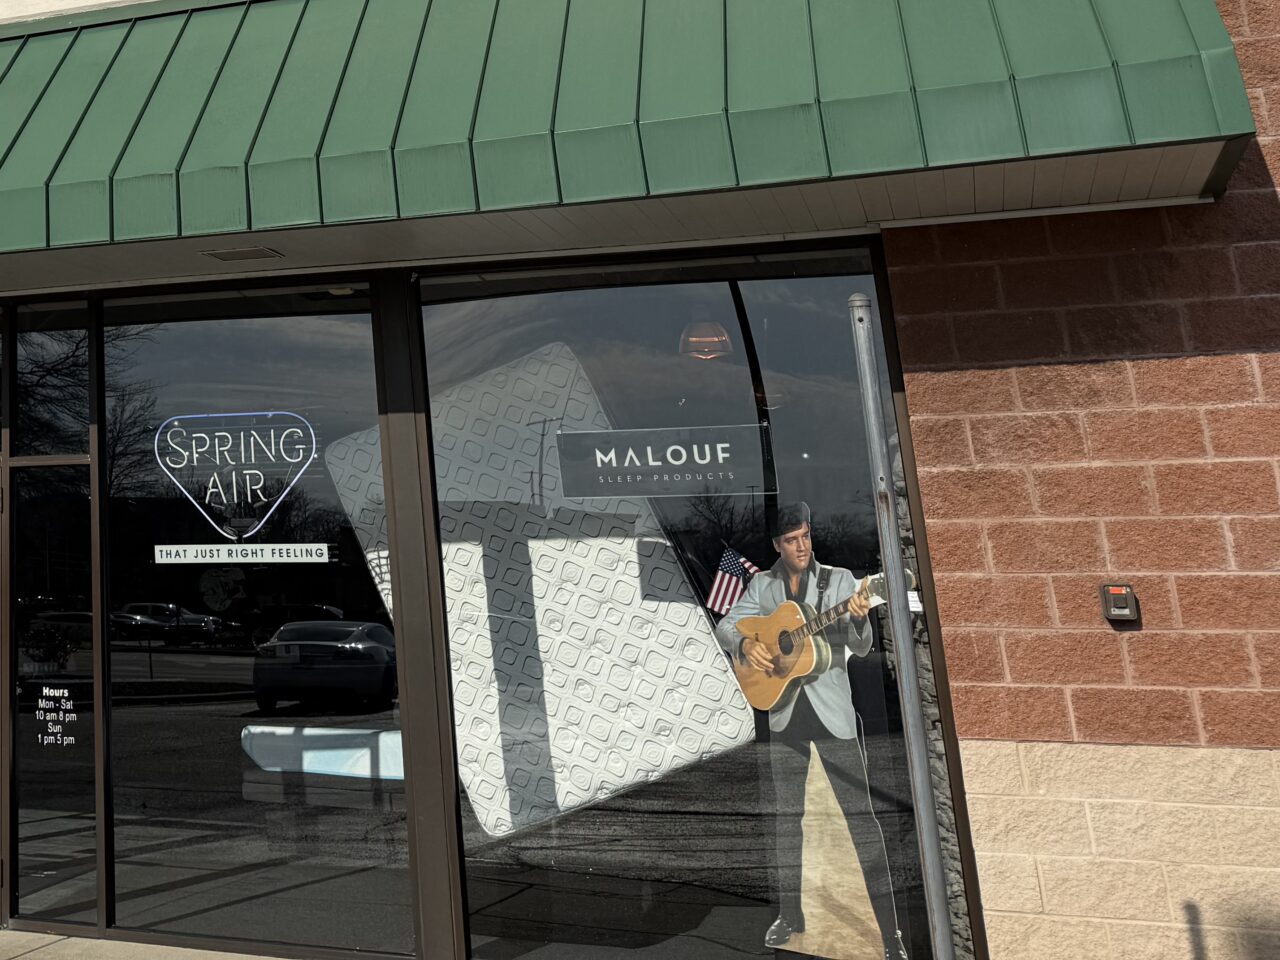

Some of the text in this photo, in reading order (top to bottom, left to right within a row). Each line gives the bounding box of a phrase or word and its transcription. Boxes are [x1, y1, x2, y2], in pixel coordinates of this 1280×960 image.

[166, 428, 306, 468] SPRING
[595, 443, 731, 467] MALOUF
[599, 472, 735, 483] SLEEP PRODUCTS
[205, 470, 268, 504] AIR
[159, 547, 324, 558] THAT JUST RIGHT FEELING
[42, 686, 69, 697] Hours
[38, 699, 54, 709] Mon
[60, 699, 73, 710] Sat
[35, 710, 77, 723] 10 am 8 pm
[47, 722, 62, 733] Sun
[37, 733, 75, 746] 1 pm 5 pm
